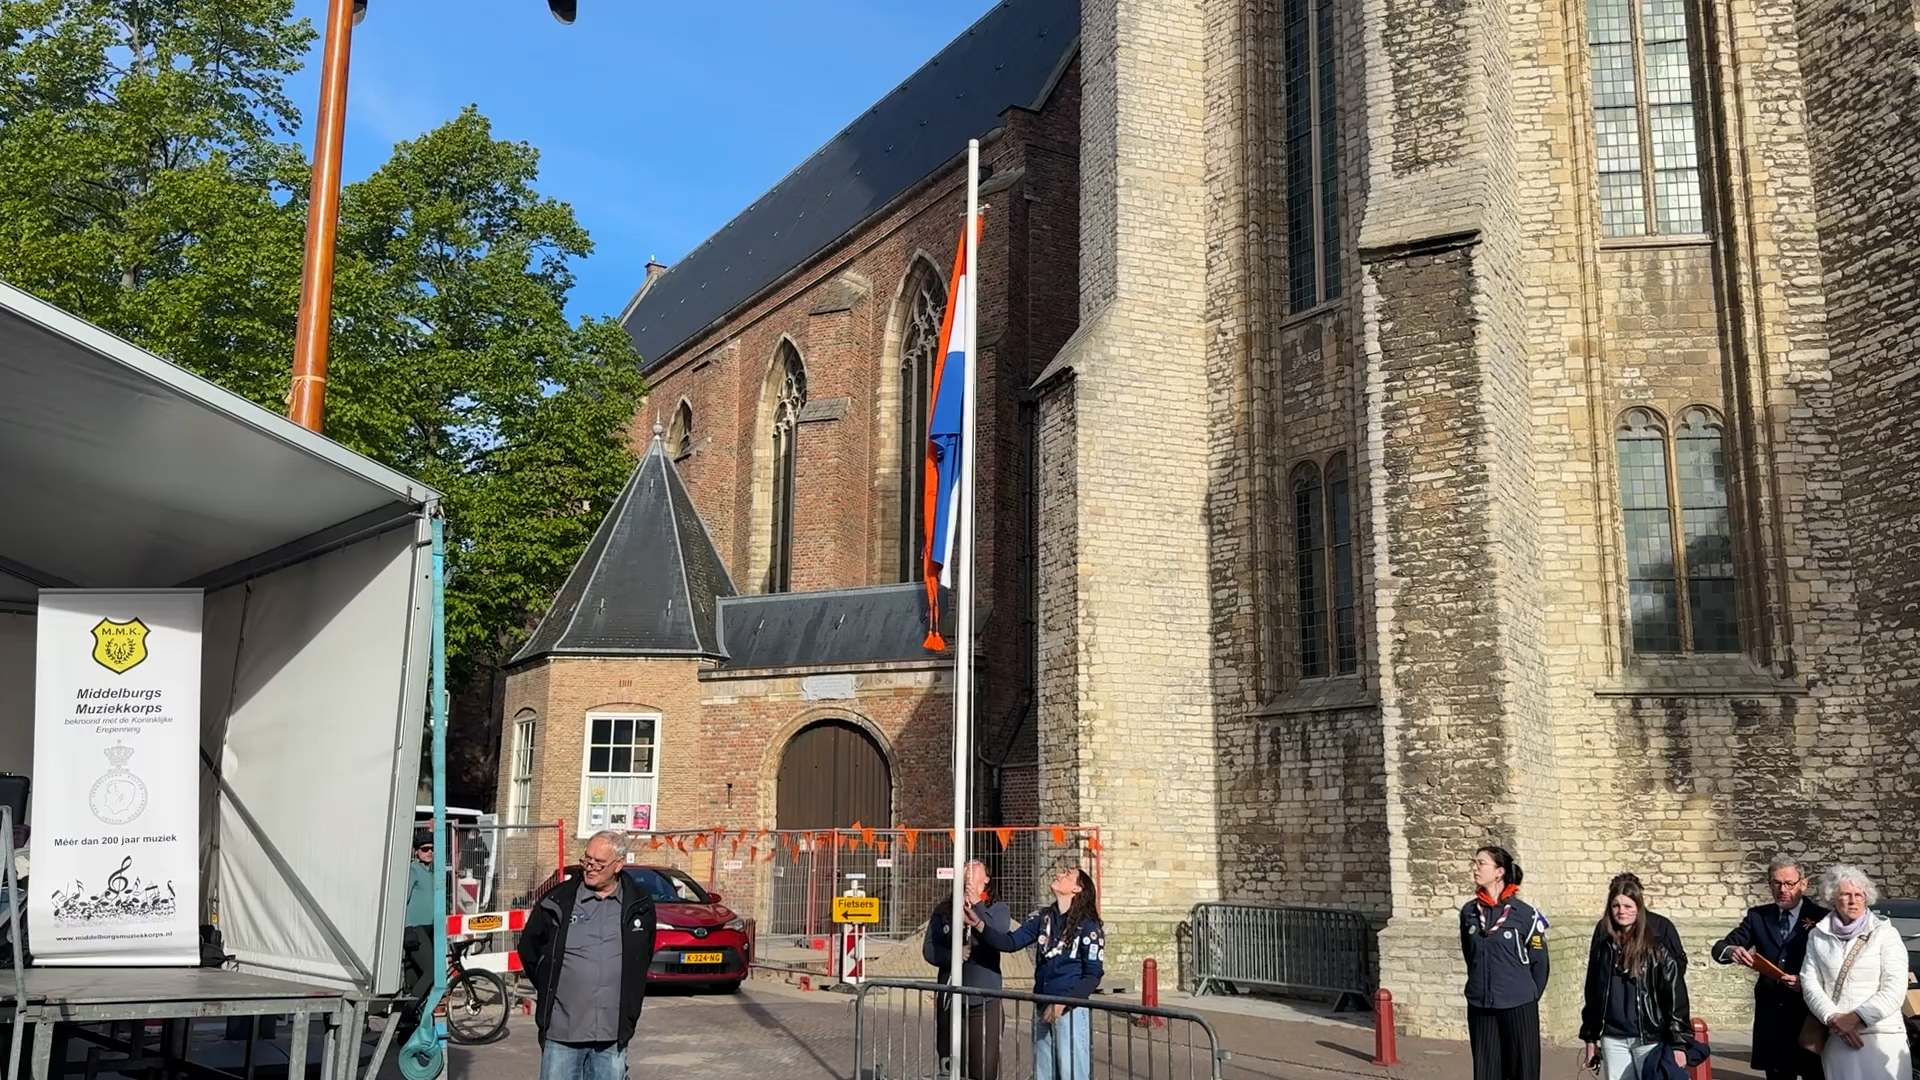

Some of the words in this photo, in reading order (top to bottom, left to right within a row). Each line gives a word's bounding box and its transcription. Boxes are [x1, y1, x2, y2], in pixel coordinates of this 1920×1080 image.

[101, 627, 141, 636] M.M.K.
[76, 688, 162, 701] Middelburgs
[75, 703, 163, 715] Muziekkorps
[64, 717, 101, 725] bekroond
[119, 716, 129, 724] de
[131, 716, 174, 724] Koninklijke
[95, 726, 142, 734] Erepenning
[54, 837, 79, 847] Méér
[80, 837, 99, 846] dan
[101, 836, 119, 845] 200
[121, 835, 140, 846] jaar
[142, 834, 178, 843] muziek
[838, 899, 874, 909] Fietsers
[55, 931, 173, 941] www.middelburgsmuziekkorps.nl
[686, 954, 721, 962] K-324-NG
